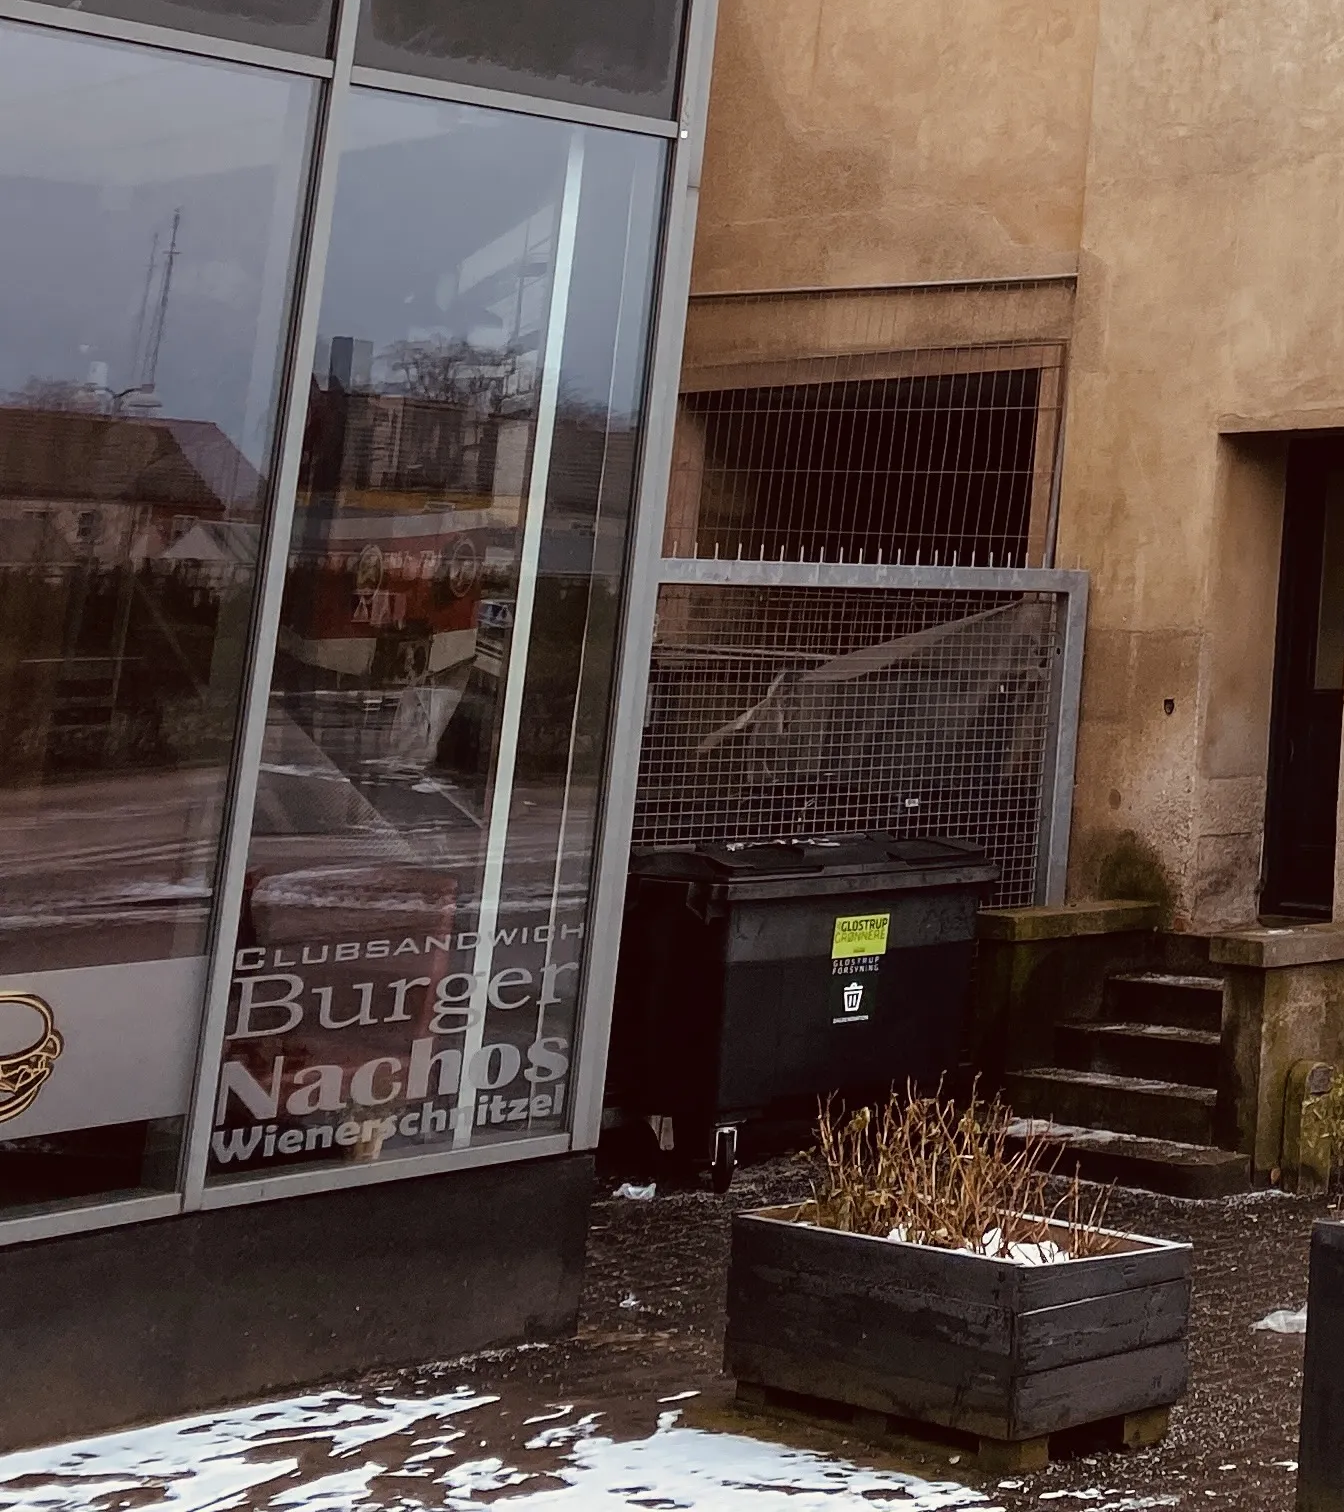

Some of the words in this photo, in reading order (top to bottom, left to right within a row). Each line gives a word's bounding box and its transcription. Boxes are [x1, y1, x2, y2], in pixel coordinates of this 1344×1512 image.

[234, 922, 585, 971] CLUBSANDWICH
[841, 917, 888, 932] GLOSTRUP
[224, 961, 580, 1041] Burger
[214, 1036, 570, 1126] Nachos
[211, 1083, 566, 1164] Wienerschnitzel
